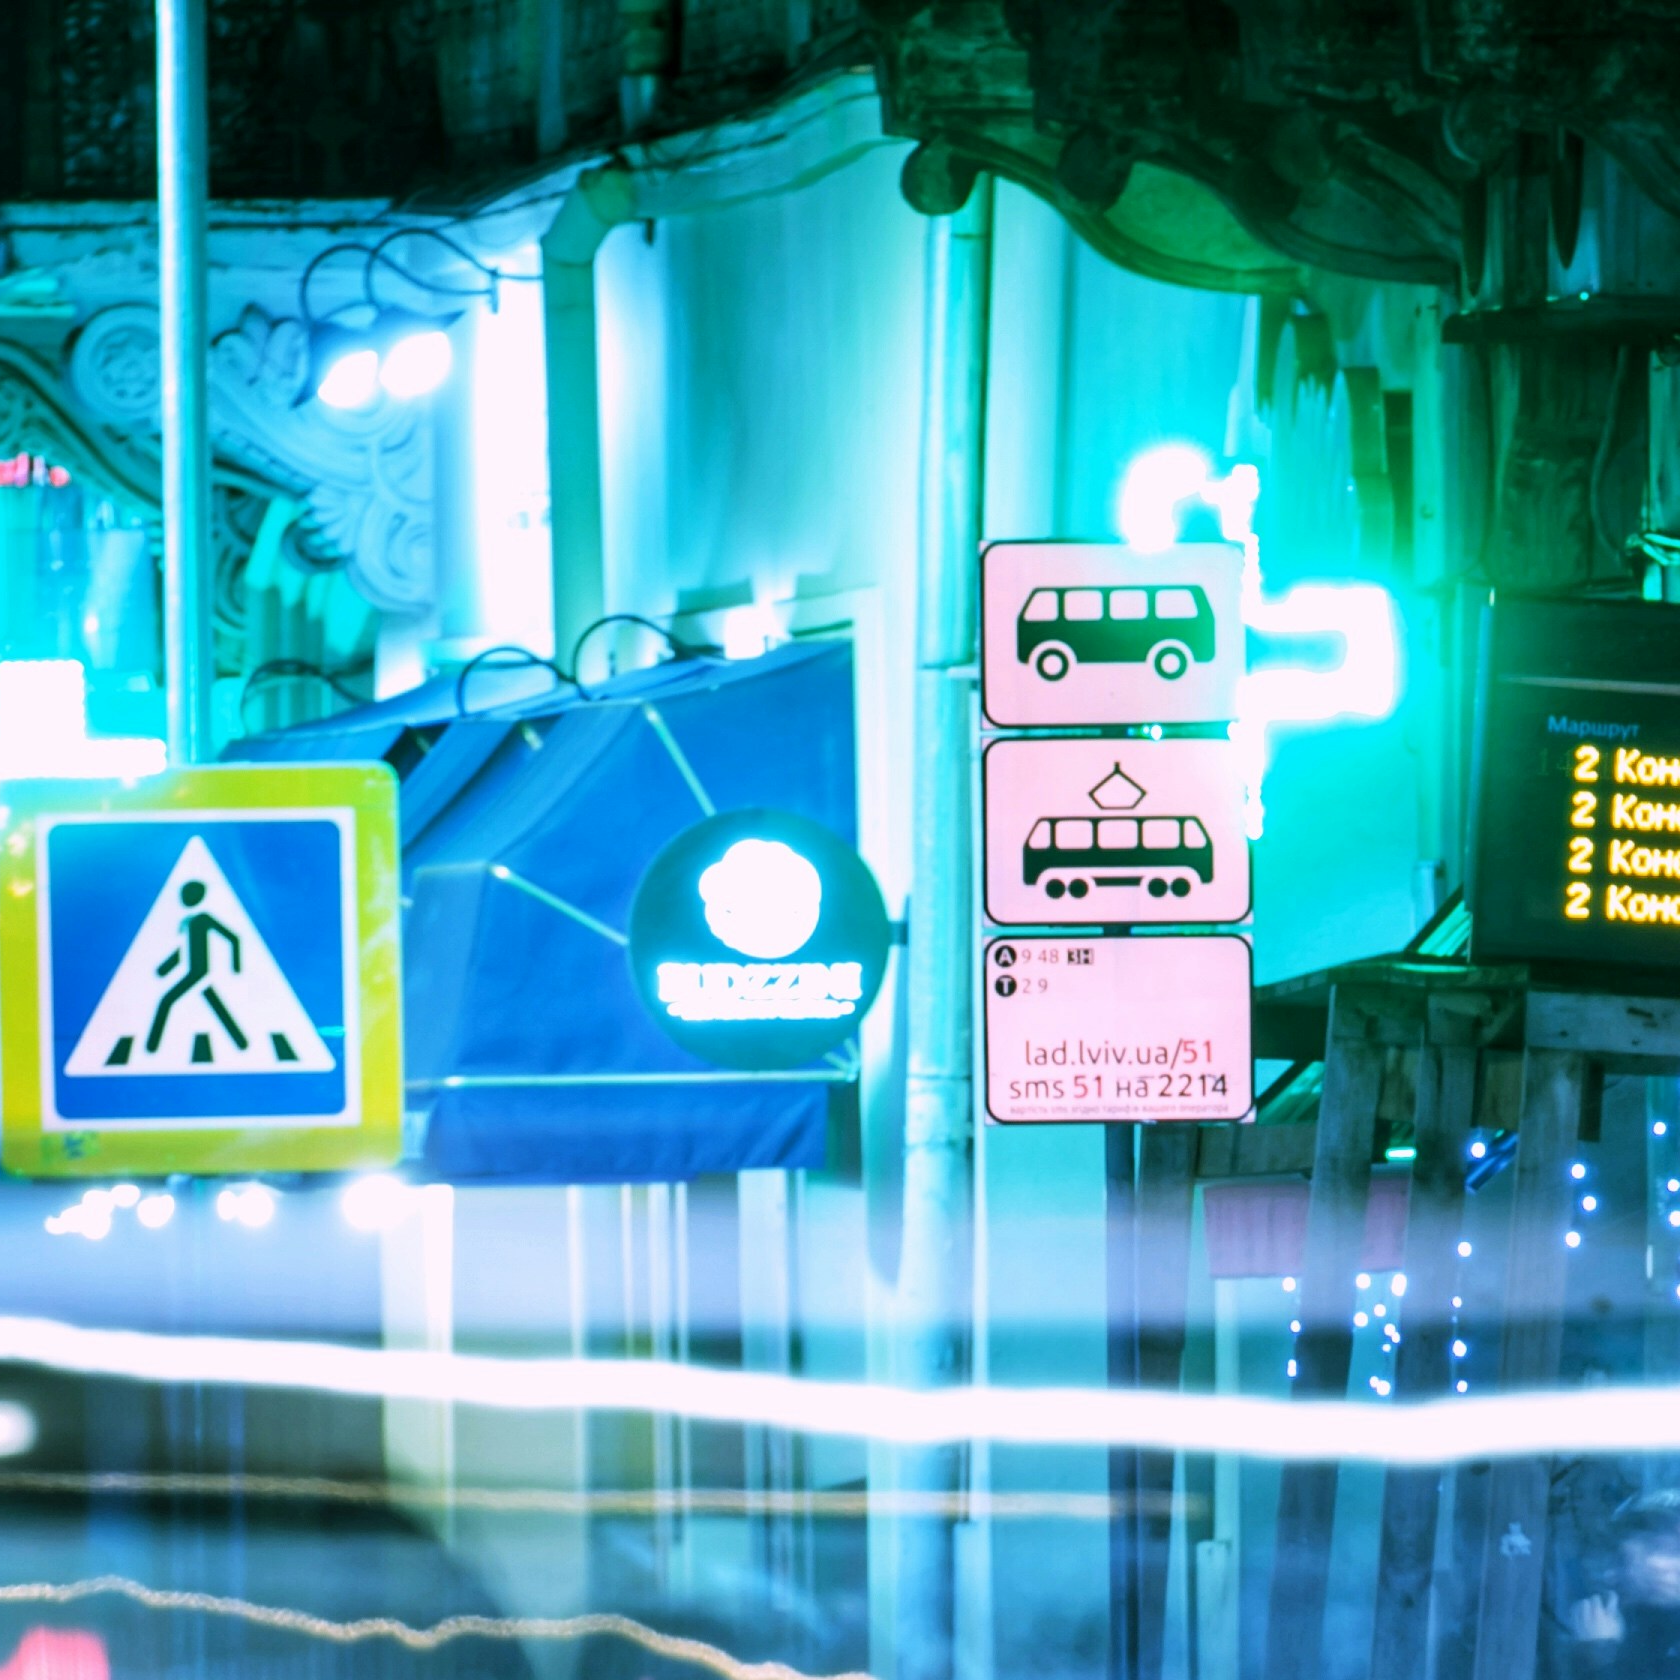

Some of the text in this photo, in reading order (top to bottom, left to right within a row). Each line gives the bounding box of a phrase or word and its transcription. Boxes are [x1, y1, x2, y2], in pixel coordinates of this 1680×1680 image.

[1548, 714, 1639, 741] Маршрут
[1574, 745, 1600, 783] 2
[1571, 791, 1597, 829] 2
[1568, 837, 1594, 874] 2
[1565, 881, 1591, 919] 2
[1021, 948, 1032, 964] 9
[1038, 948, 1060, 964] 48
[1022, 978, 1031, 993] 2
[1038, 978, 1048, 993] 9
[1025, 1038, 1213, 1070] lad.lviv.ua/51
[1009, 1074, 1229, 1100] sms 51 на 2214
